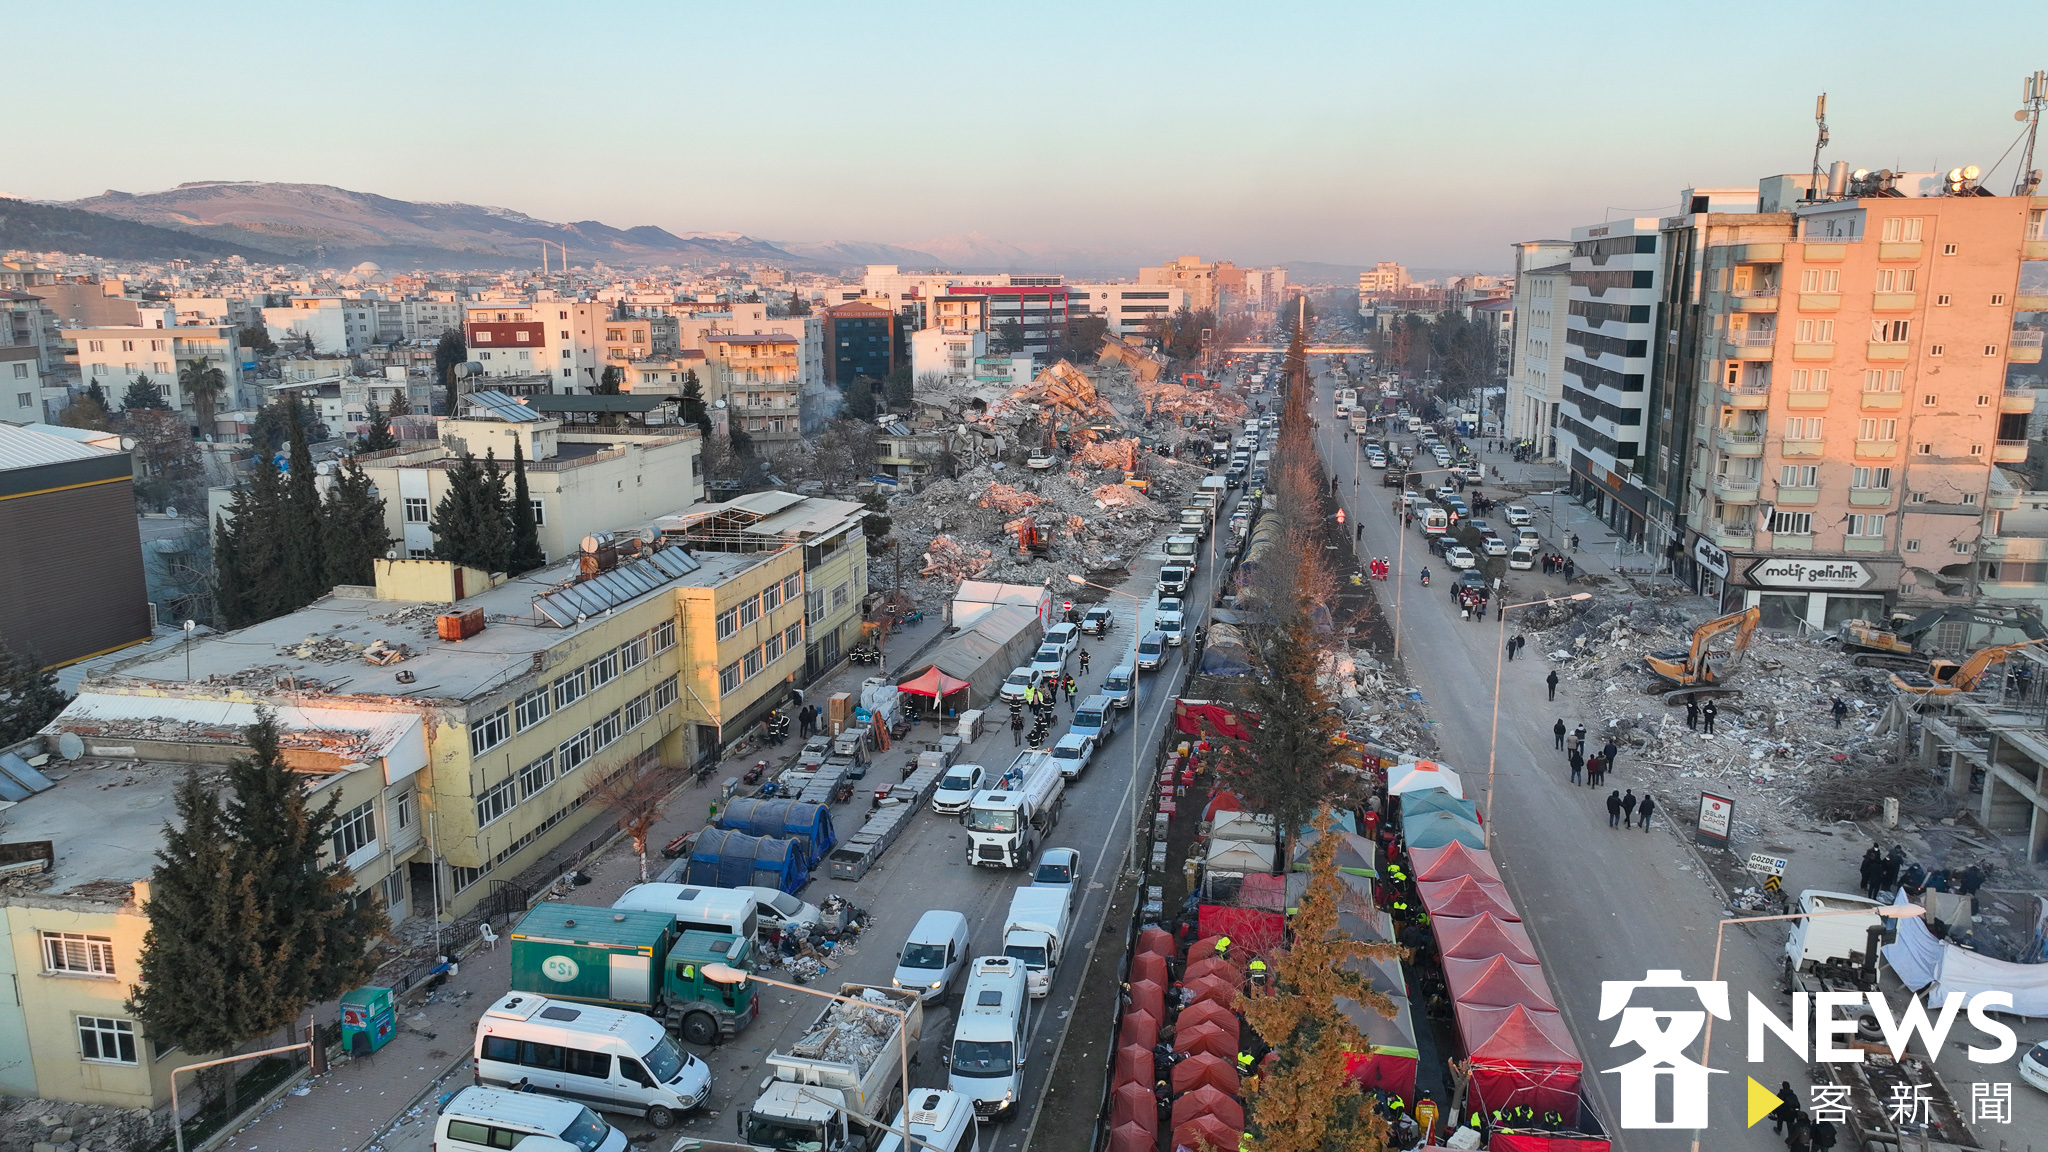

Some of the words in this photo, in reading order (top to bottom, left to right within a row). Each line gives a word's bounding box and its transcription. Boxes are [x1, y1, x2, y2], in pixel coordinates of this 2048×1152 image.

[1765, 563, 1807, 582] motif
[1808, 564, 1858, 582] gelinlik
[1973, 615, 2004, 625] VOLVO
